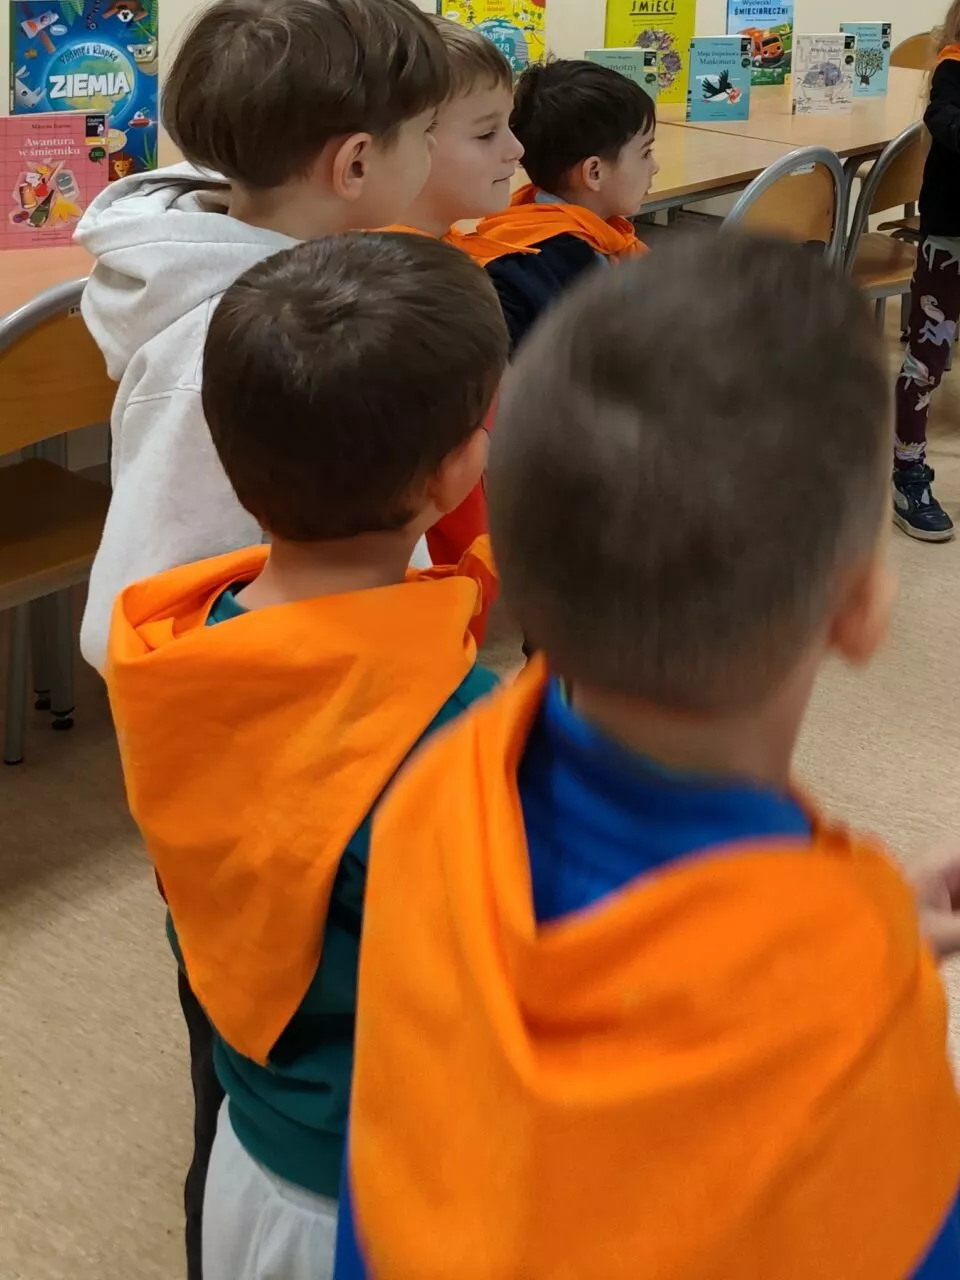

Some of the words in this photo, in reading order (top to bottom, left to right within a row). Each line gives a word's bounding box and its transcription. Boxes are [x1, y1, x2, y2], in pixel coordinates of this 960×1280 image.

[49, 71, 132, 100] ZIEMIA
[25, 137, 75, 147] Awantura
[29, 145, 81, 157] śmietniku
